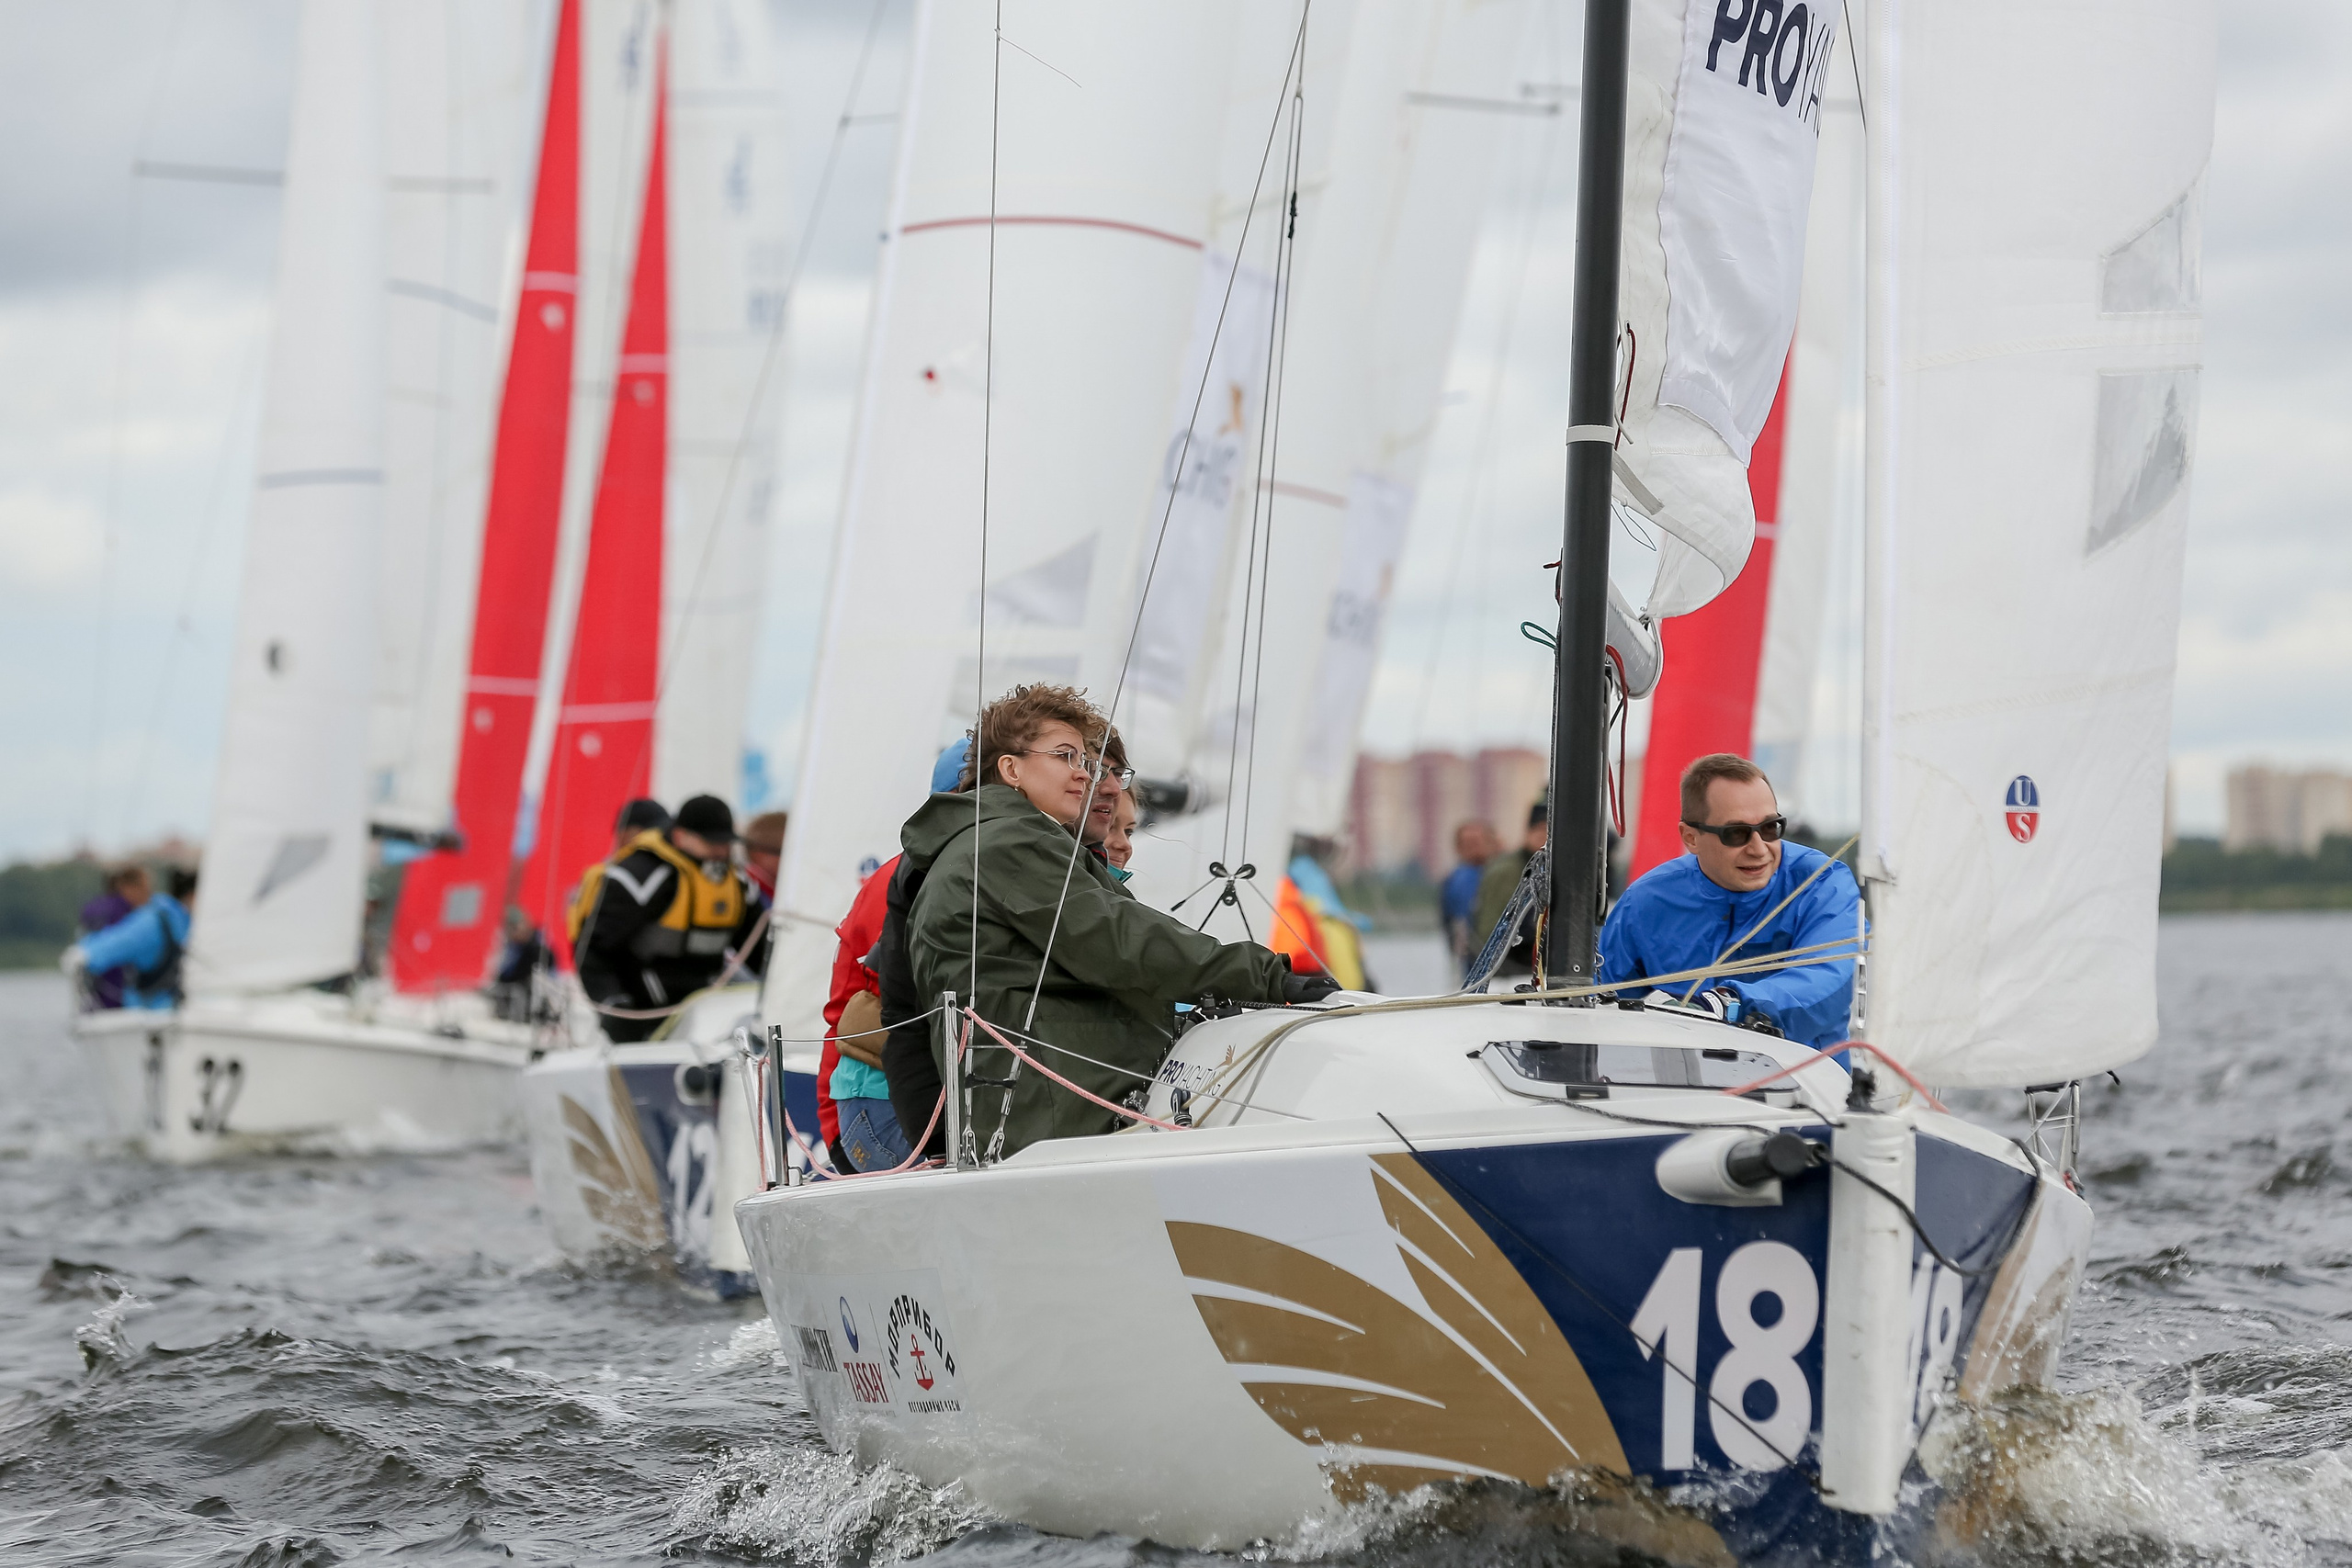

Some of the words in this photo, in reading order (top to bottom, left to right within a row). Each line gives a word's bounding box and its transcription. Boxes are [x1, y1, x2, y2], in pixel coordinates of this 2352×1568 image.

[1706, 0, 1836, 139] PROYA
[842, 1361, 889, 1404] TASSAY
[1630, 1240, 1819, 1472] 18
